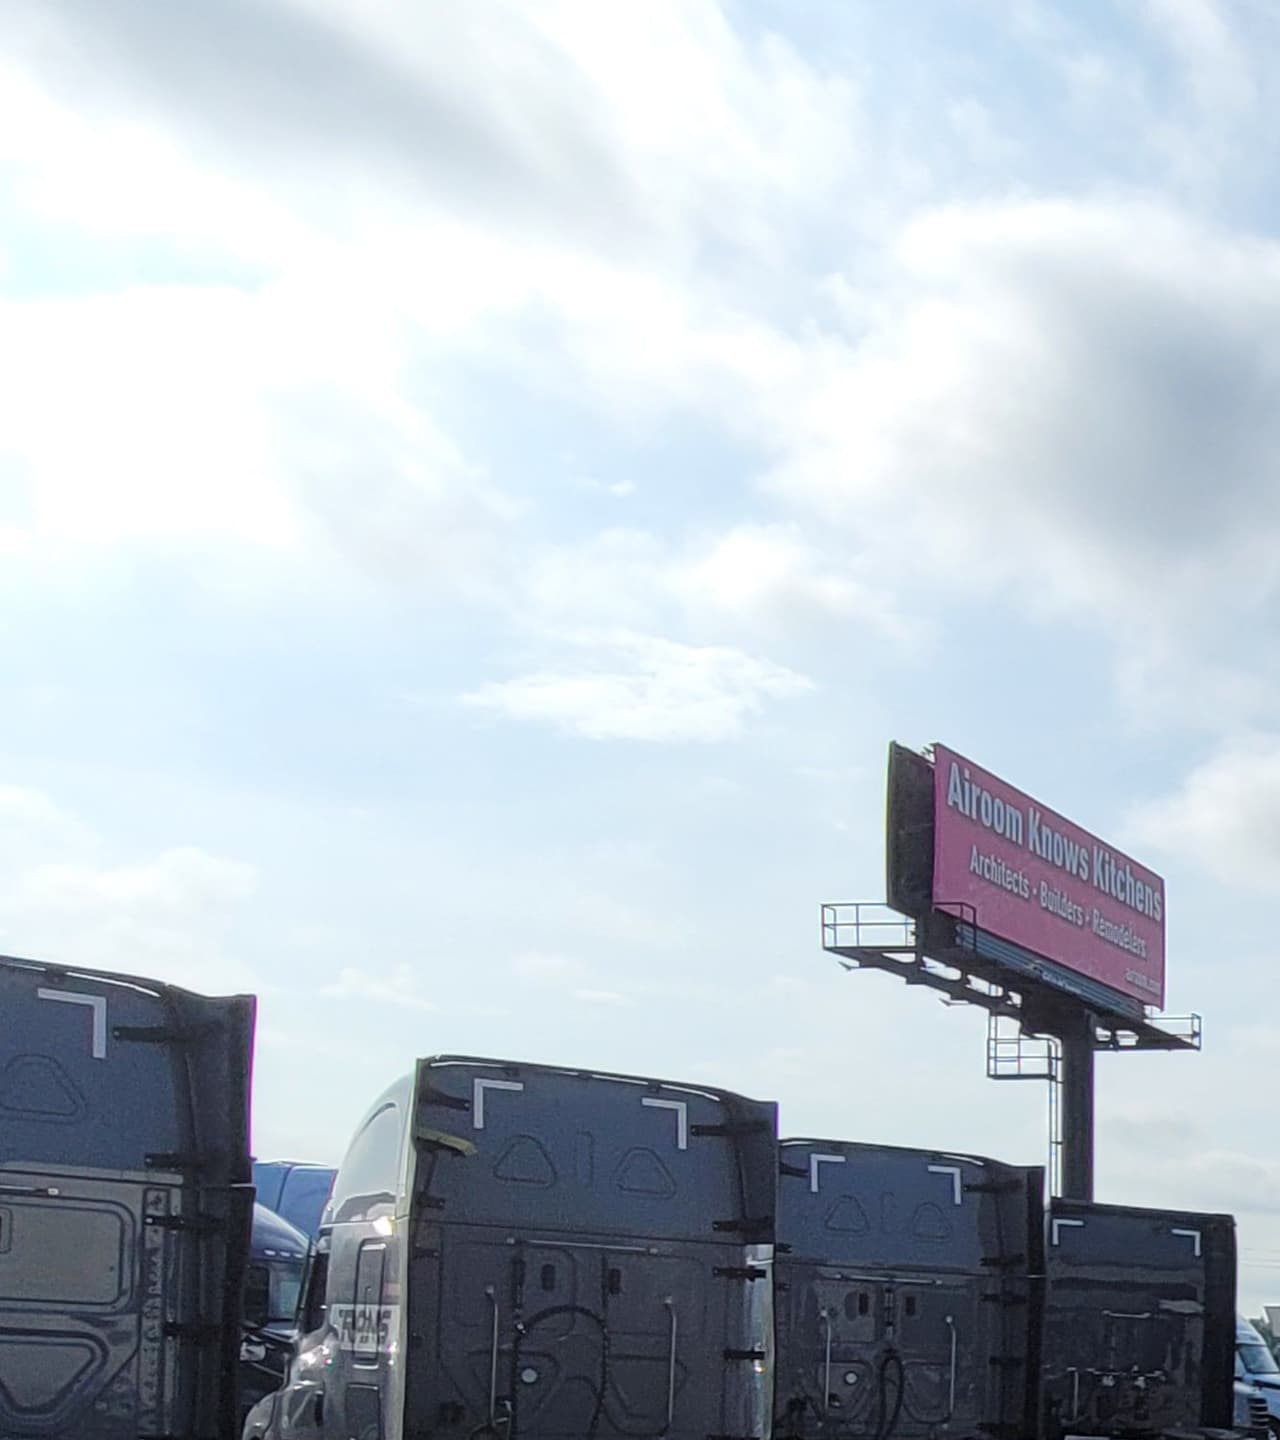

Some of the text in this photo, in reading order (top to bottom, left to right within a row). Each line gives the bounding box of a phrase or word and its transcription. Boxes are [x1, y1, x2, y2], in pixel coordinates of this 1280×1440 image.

[948, 762, 1162, 922] Airoom Knows Kitchens
[969, 845, 1147, 958] Architects Builders Remodelers
